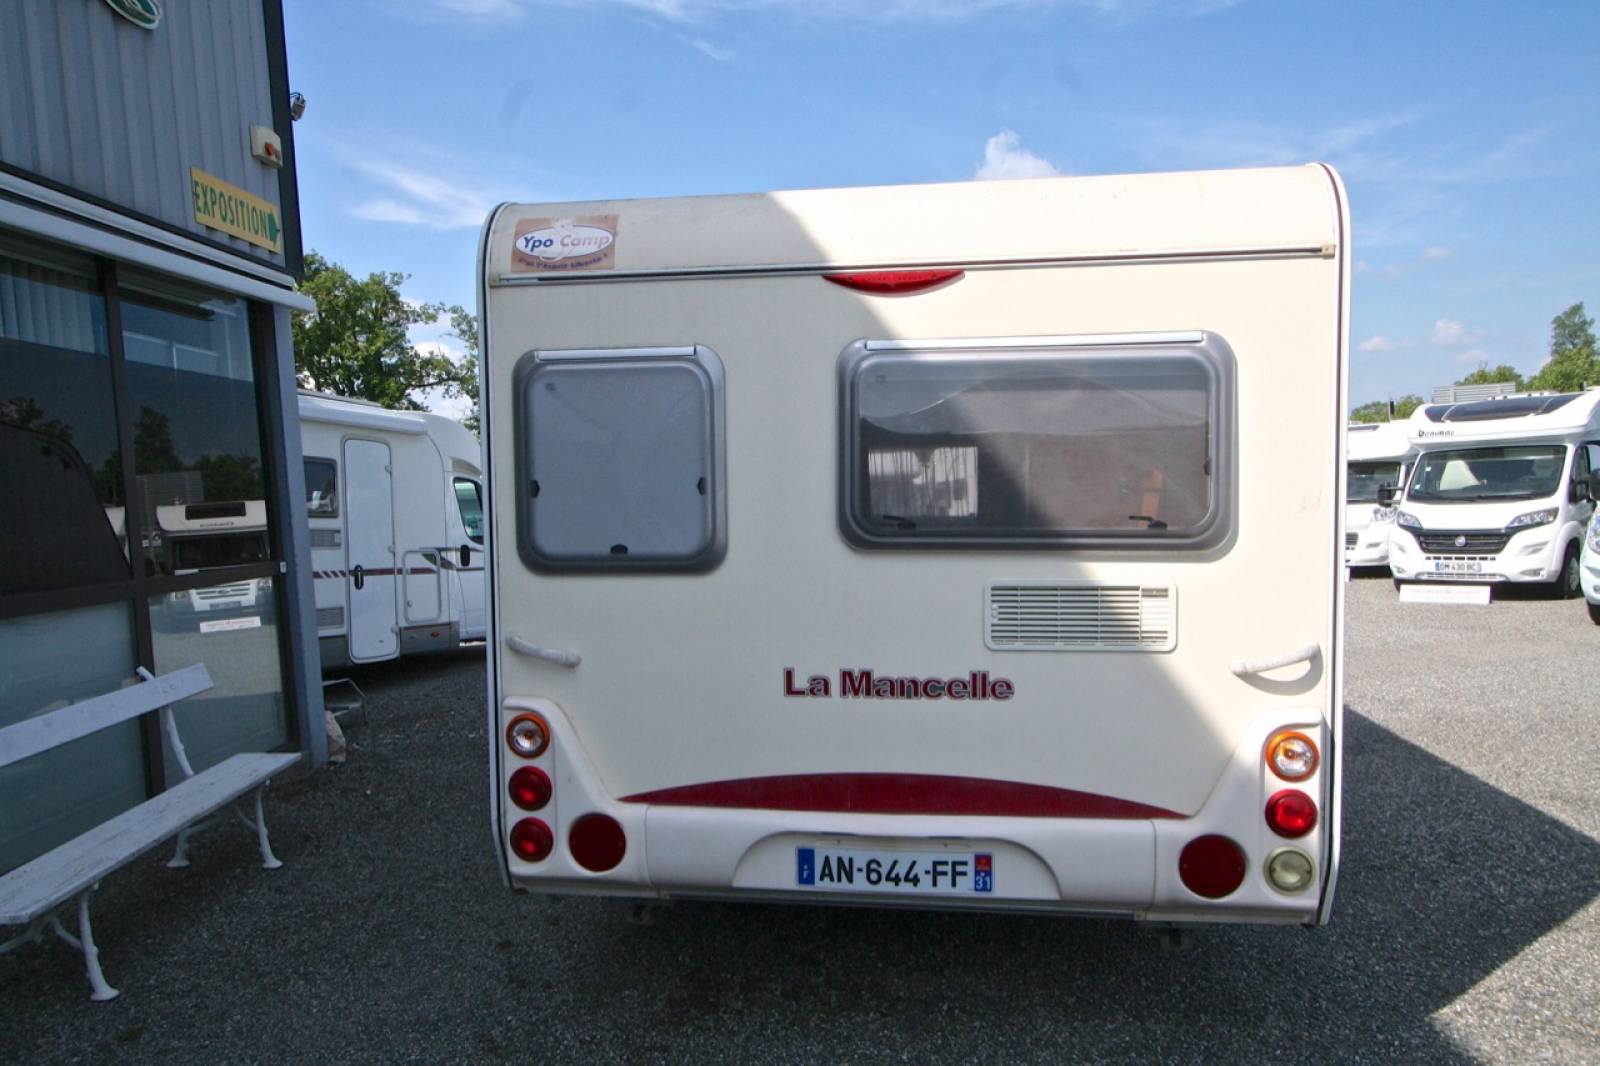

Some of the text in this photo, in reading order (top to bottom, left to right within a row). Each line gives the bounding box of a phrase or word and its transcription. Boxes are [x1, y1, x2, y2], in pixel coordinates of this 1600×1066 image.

[192, 179, 268, 240] EXPOSITION
[523, 234, 610, 252] Ypo Camp
[783, 667, 1016, 701] La Mancelle
[819, 855, 969, 888] AN-644-FF
[975, 875, 991, 890] 31
